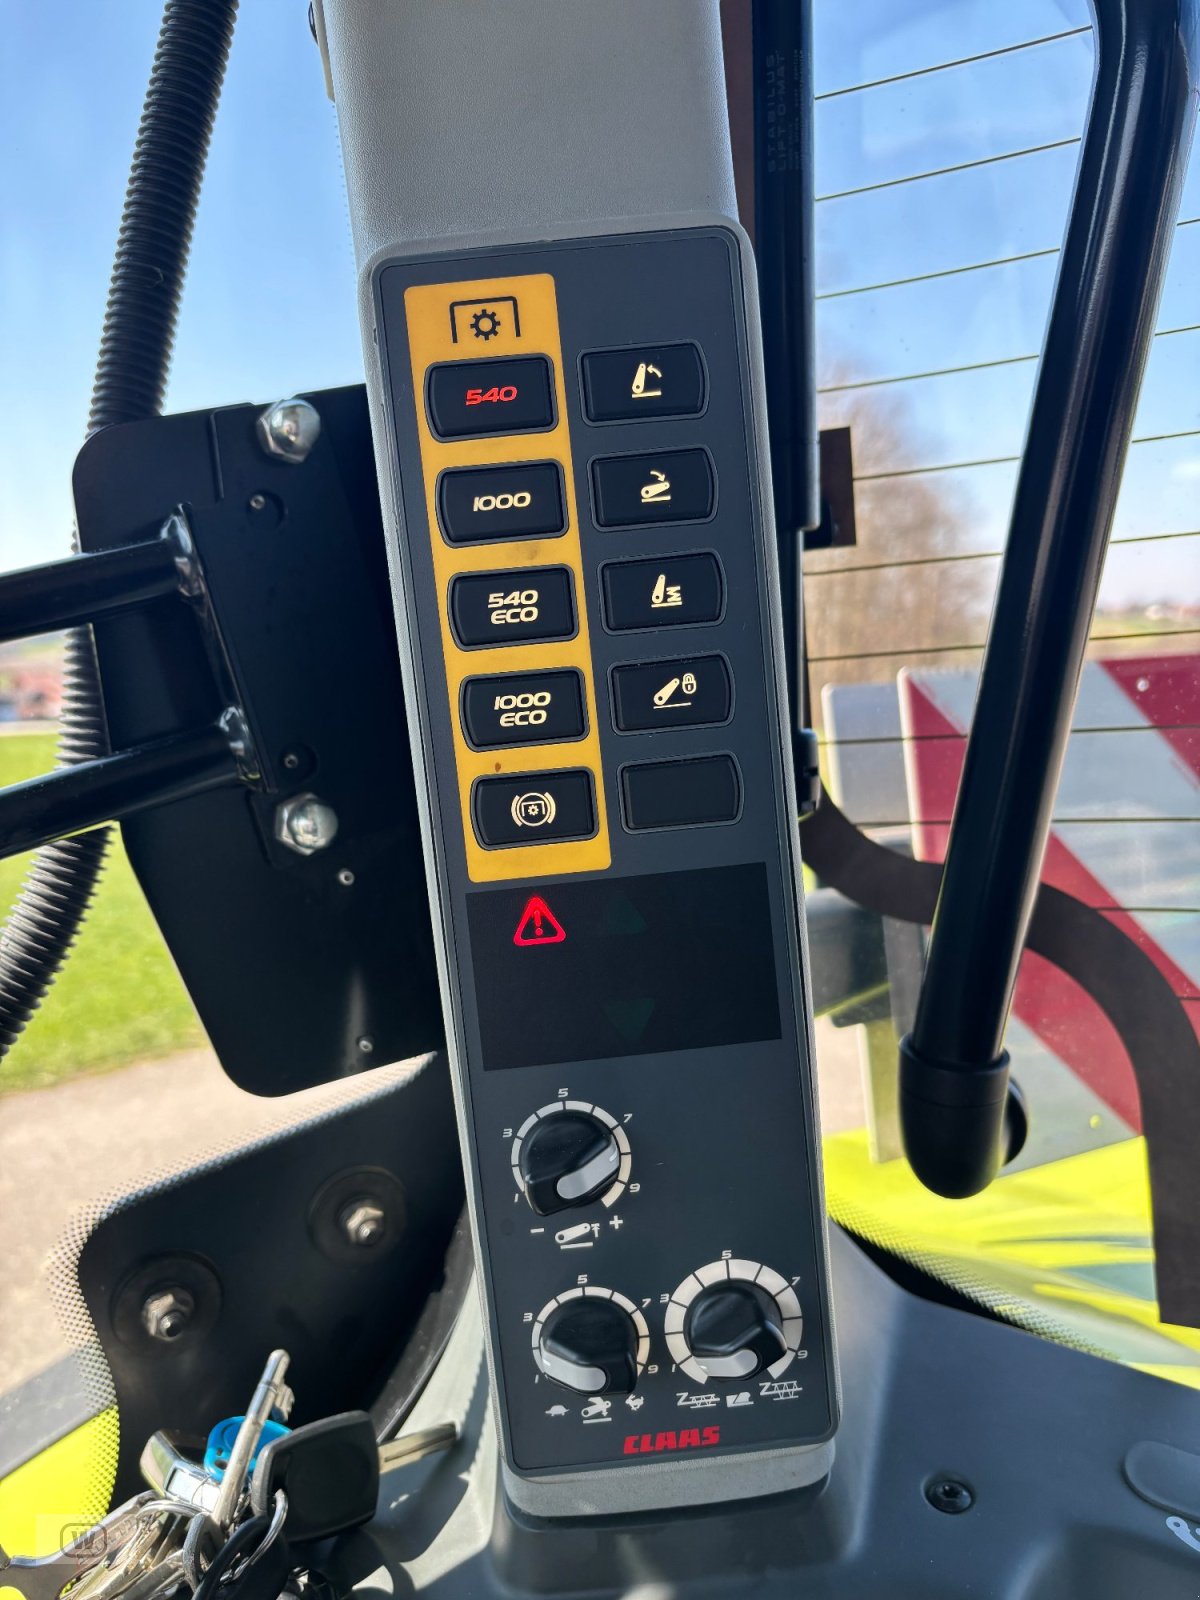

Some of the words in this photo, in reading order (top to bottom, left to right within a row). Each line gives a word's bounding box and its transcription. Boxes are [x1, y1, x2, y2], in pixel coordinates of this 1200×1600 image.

[766, 55, 777, 173] STABILUS
[465, 385, 517, 406] 540
[473, 492, 532, 512] 1000
[487, 589, 539, 607] 540
[490, 606, 538, 625] ECO
[494, 691, 552, 709] 1000
[499, 708, 550, 727] ECO
[558, 1087, 569, 1098] 5
[623, 1113, 633, 1123] 7
[502, 1128, 513, 1138] 3
[629, 1183, 641, 1193] 9
[721, 1250, 732, 1259] 5
[577, 1274, 588, 1284] 5
[791, 1276, 801, 1286] 7
[642, 1298, 651, 1307] 7
[660, 1293, 670, 1303] 3
[522, 1312, 533, 1322] 3
[797, 1350, 808, 1360] 9
[647, 1363, 659, 1374] 9
[623, 1425, 721, 1456] CLAAS
